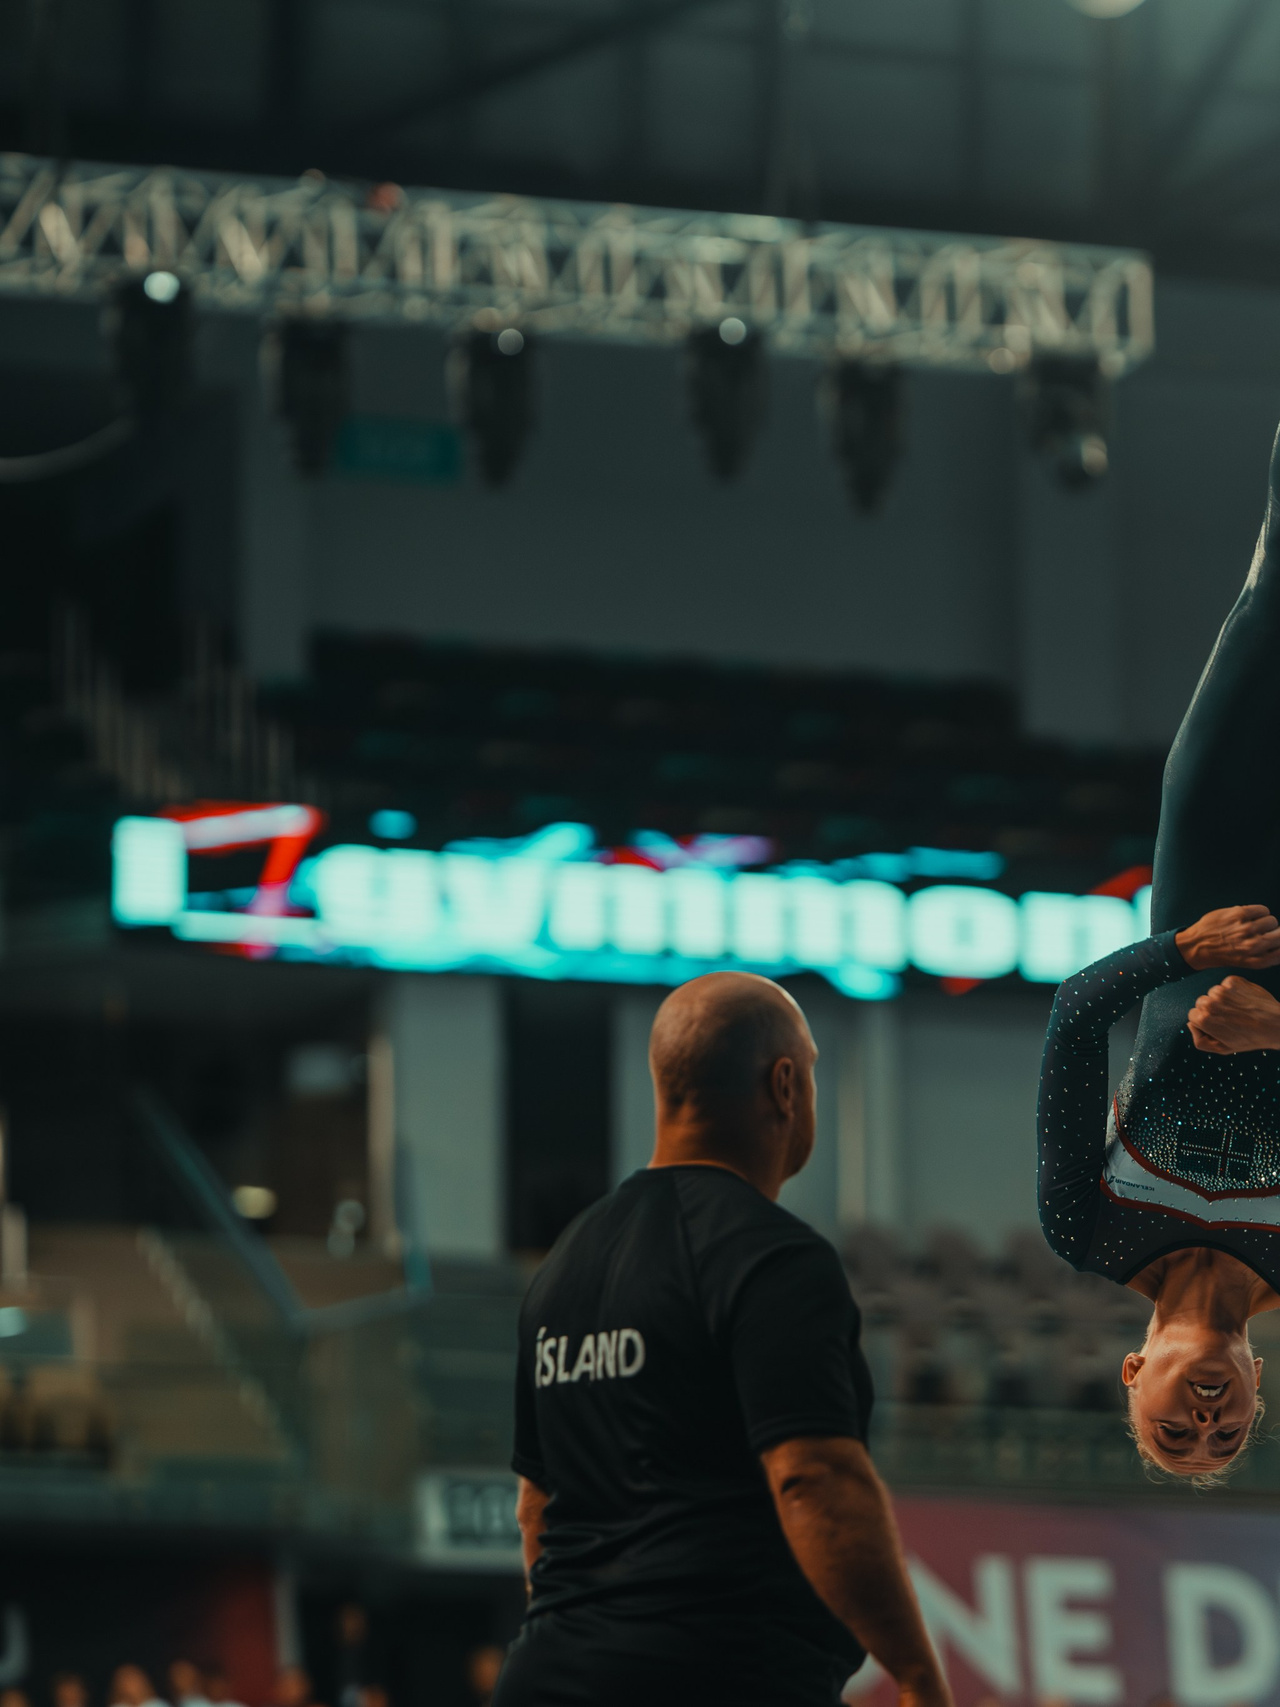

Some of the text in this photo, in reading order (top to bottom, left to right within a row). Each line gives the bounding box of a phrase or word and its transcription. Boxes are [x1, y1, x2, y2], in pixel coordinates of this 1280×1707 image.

[1114, 1177, 1155, 1192] ICELANDAIR
[535, 1326, 646, 1389] ÍSLAND
[842, 1555, 1122, 1705] NE
